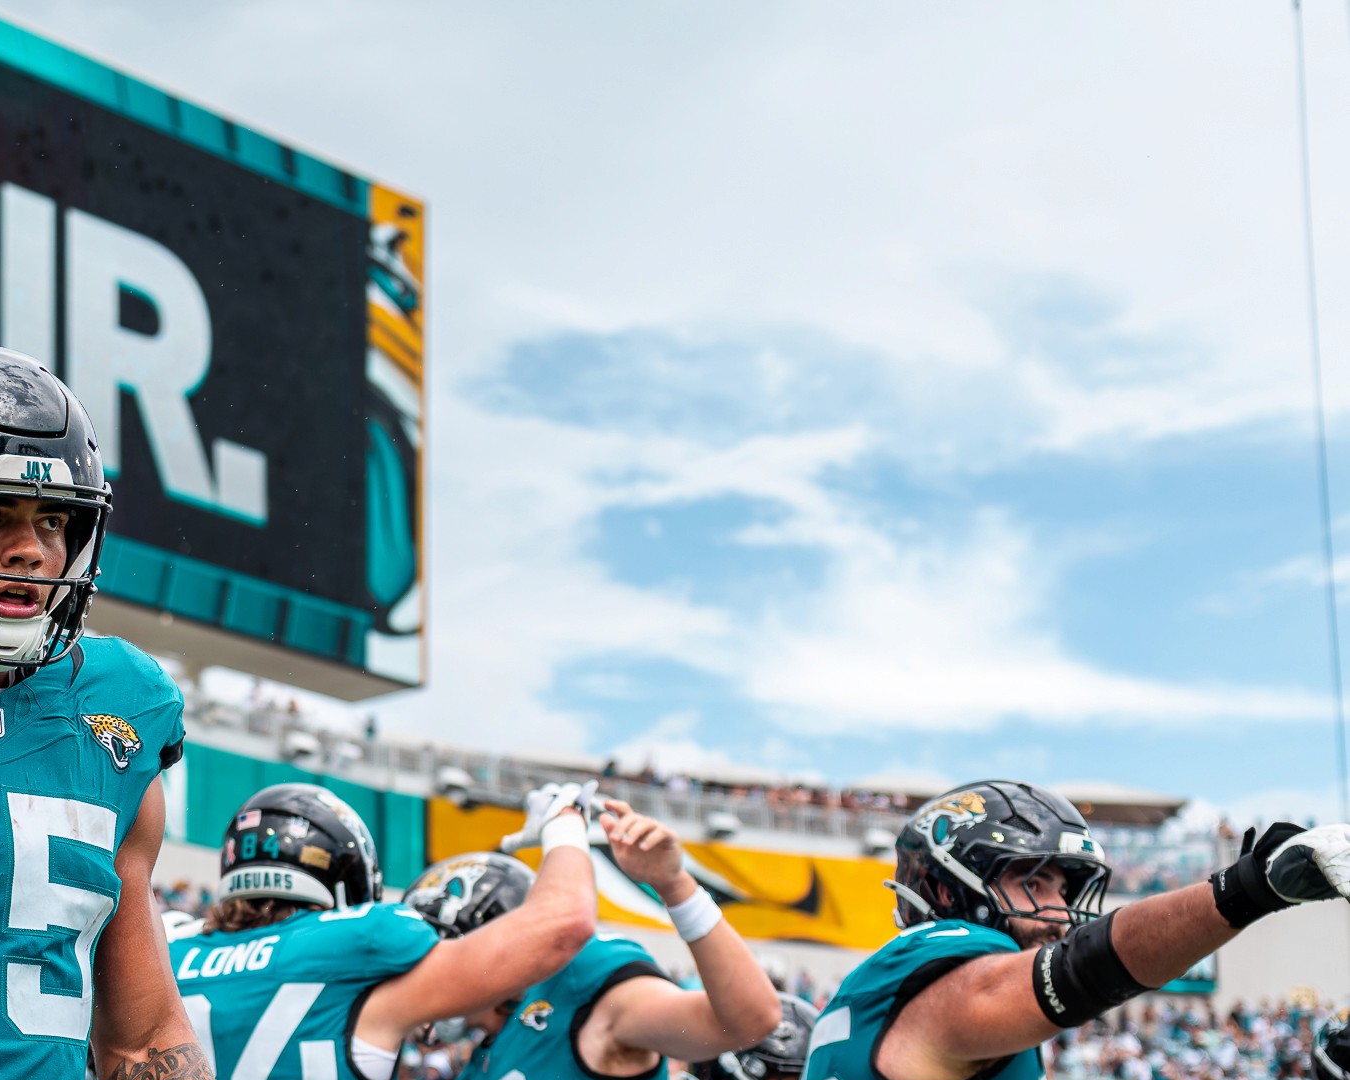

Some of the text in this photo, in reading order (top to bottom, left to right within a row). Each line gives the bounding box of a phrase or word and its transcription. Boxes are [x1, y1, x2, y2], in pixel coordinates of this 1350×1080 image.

[21, 460, 52, 482] JAX
[240, 832, 281, 860] 84
[228, 871, 293, 893] JAGUARS
[177, 935, 280, 980] LONG
